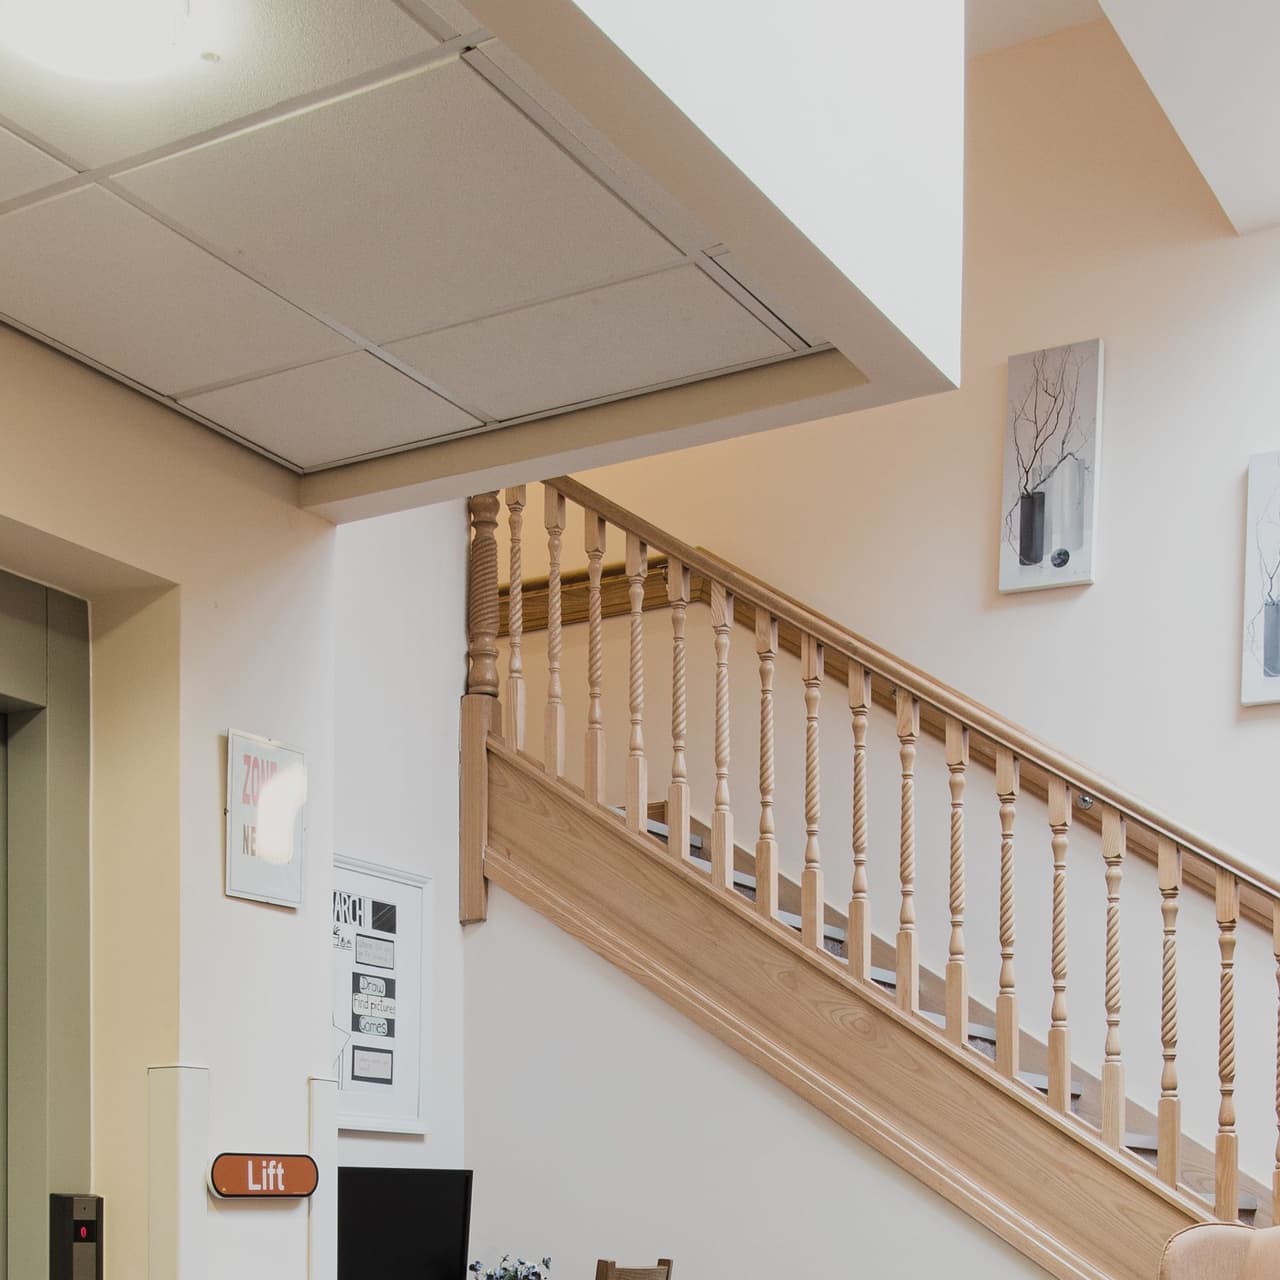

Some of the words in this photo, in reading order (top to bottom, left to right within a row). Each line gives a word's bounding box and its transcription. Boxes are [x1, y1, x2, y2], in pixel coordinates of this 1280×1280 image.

[361, 976, 384, 993] Draw
[354, 993, 368, 1009] Find
[359, 1017, 386, 1034] Games
[247, 1159, 286, 1191] Lift
